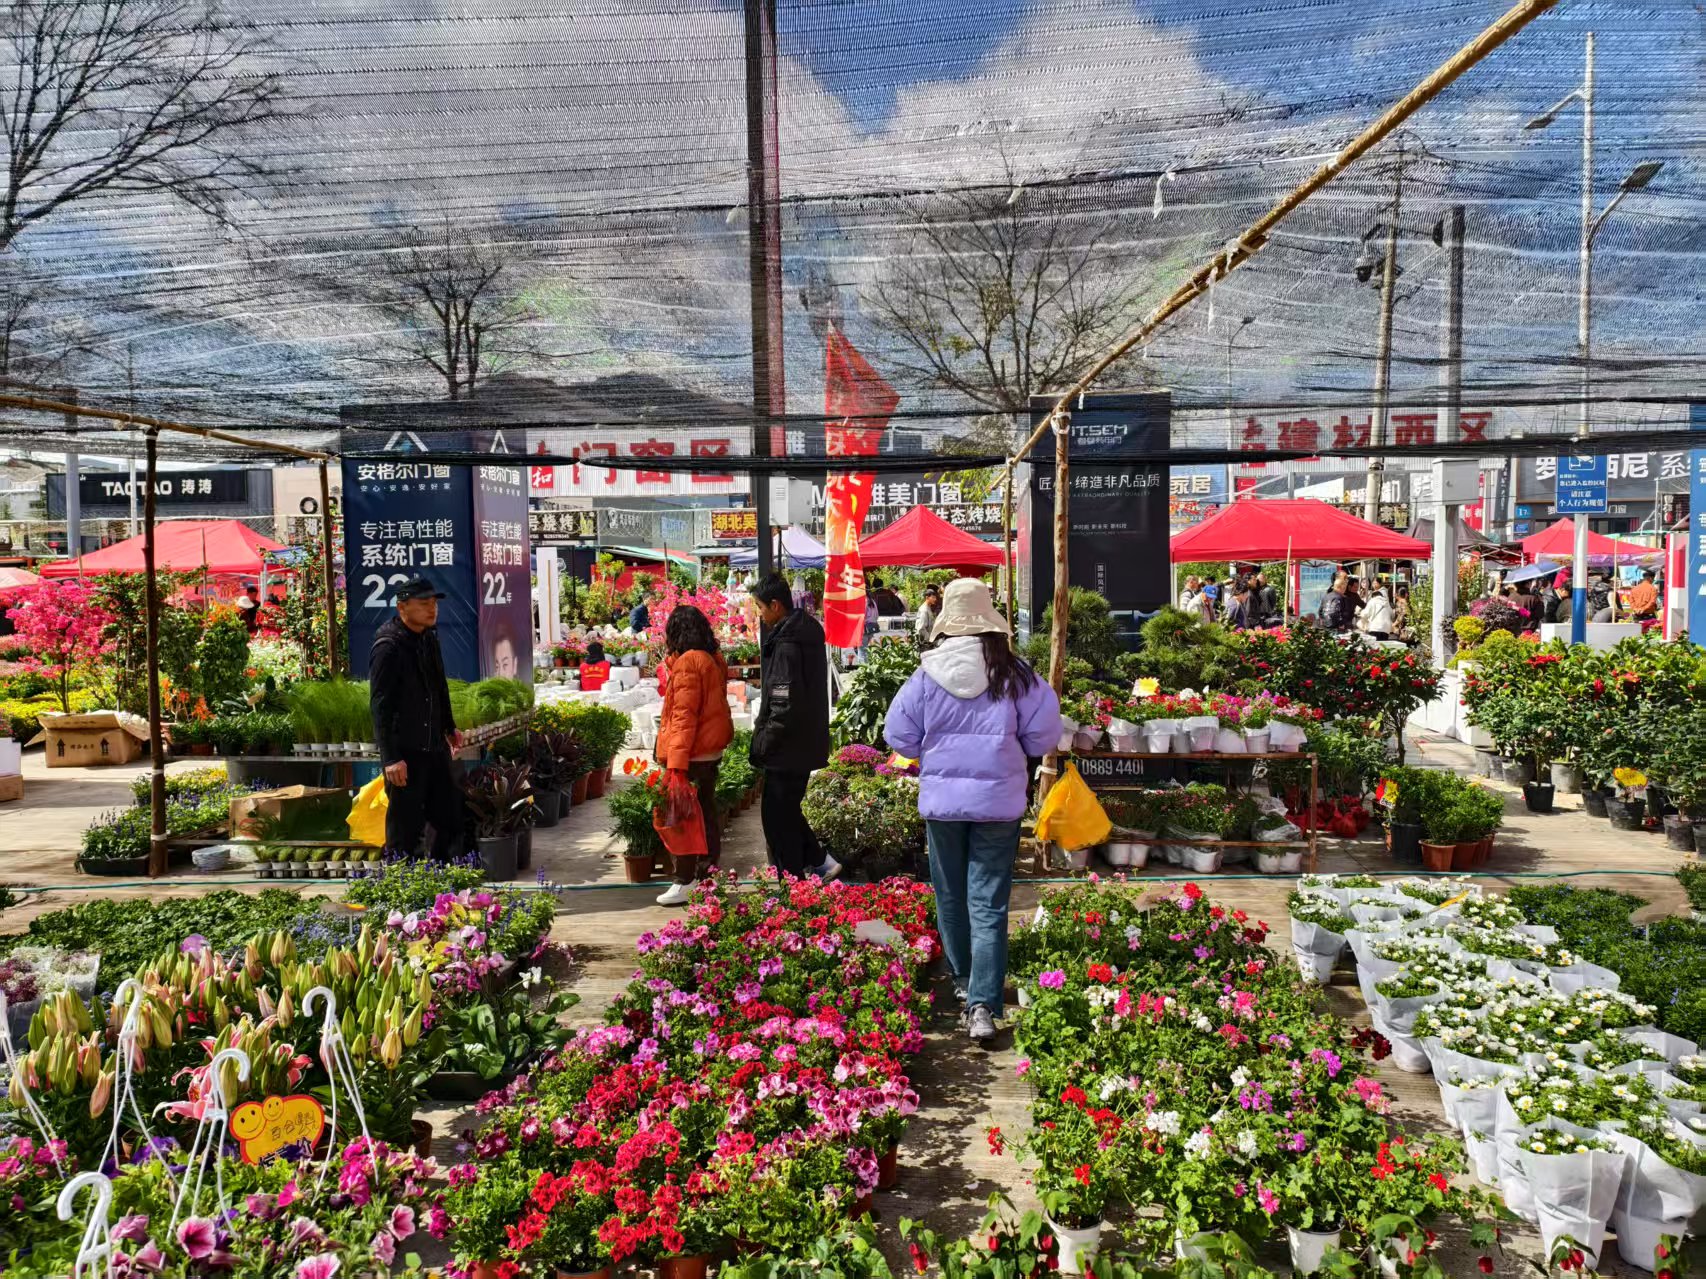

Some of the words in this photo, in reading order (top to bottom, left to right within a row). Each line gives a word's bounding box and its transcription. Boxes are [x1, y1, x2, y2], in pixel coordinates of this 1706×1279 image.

[358, 463, 451, 480] 安格尔门窗
[479, 465, 520, 486] 安格尔门窗
[181, 478, 212, 494] 涛涛
[1039, 474, 1160, 491] 匠·缔造非凡品质
[1170, 475, 1210, 495] 家居
[360, 519, 453, 540] 专注高性能
[481, 520, 522, 541] 专注高性能
[361, 542, 454, 567] 系统门窗
[482, 543, 522, 566] 系统门窗
[1082, 759, 1113, 775] 0889
